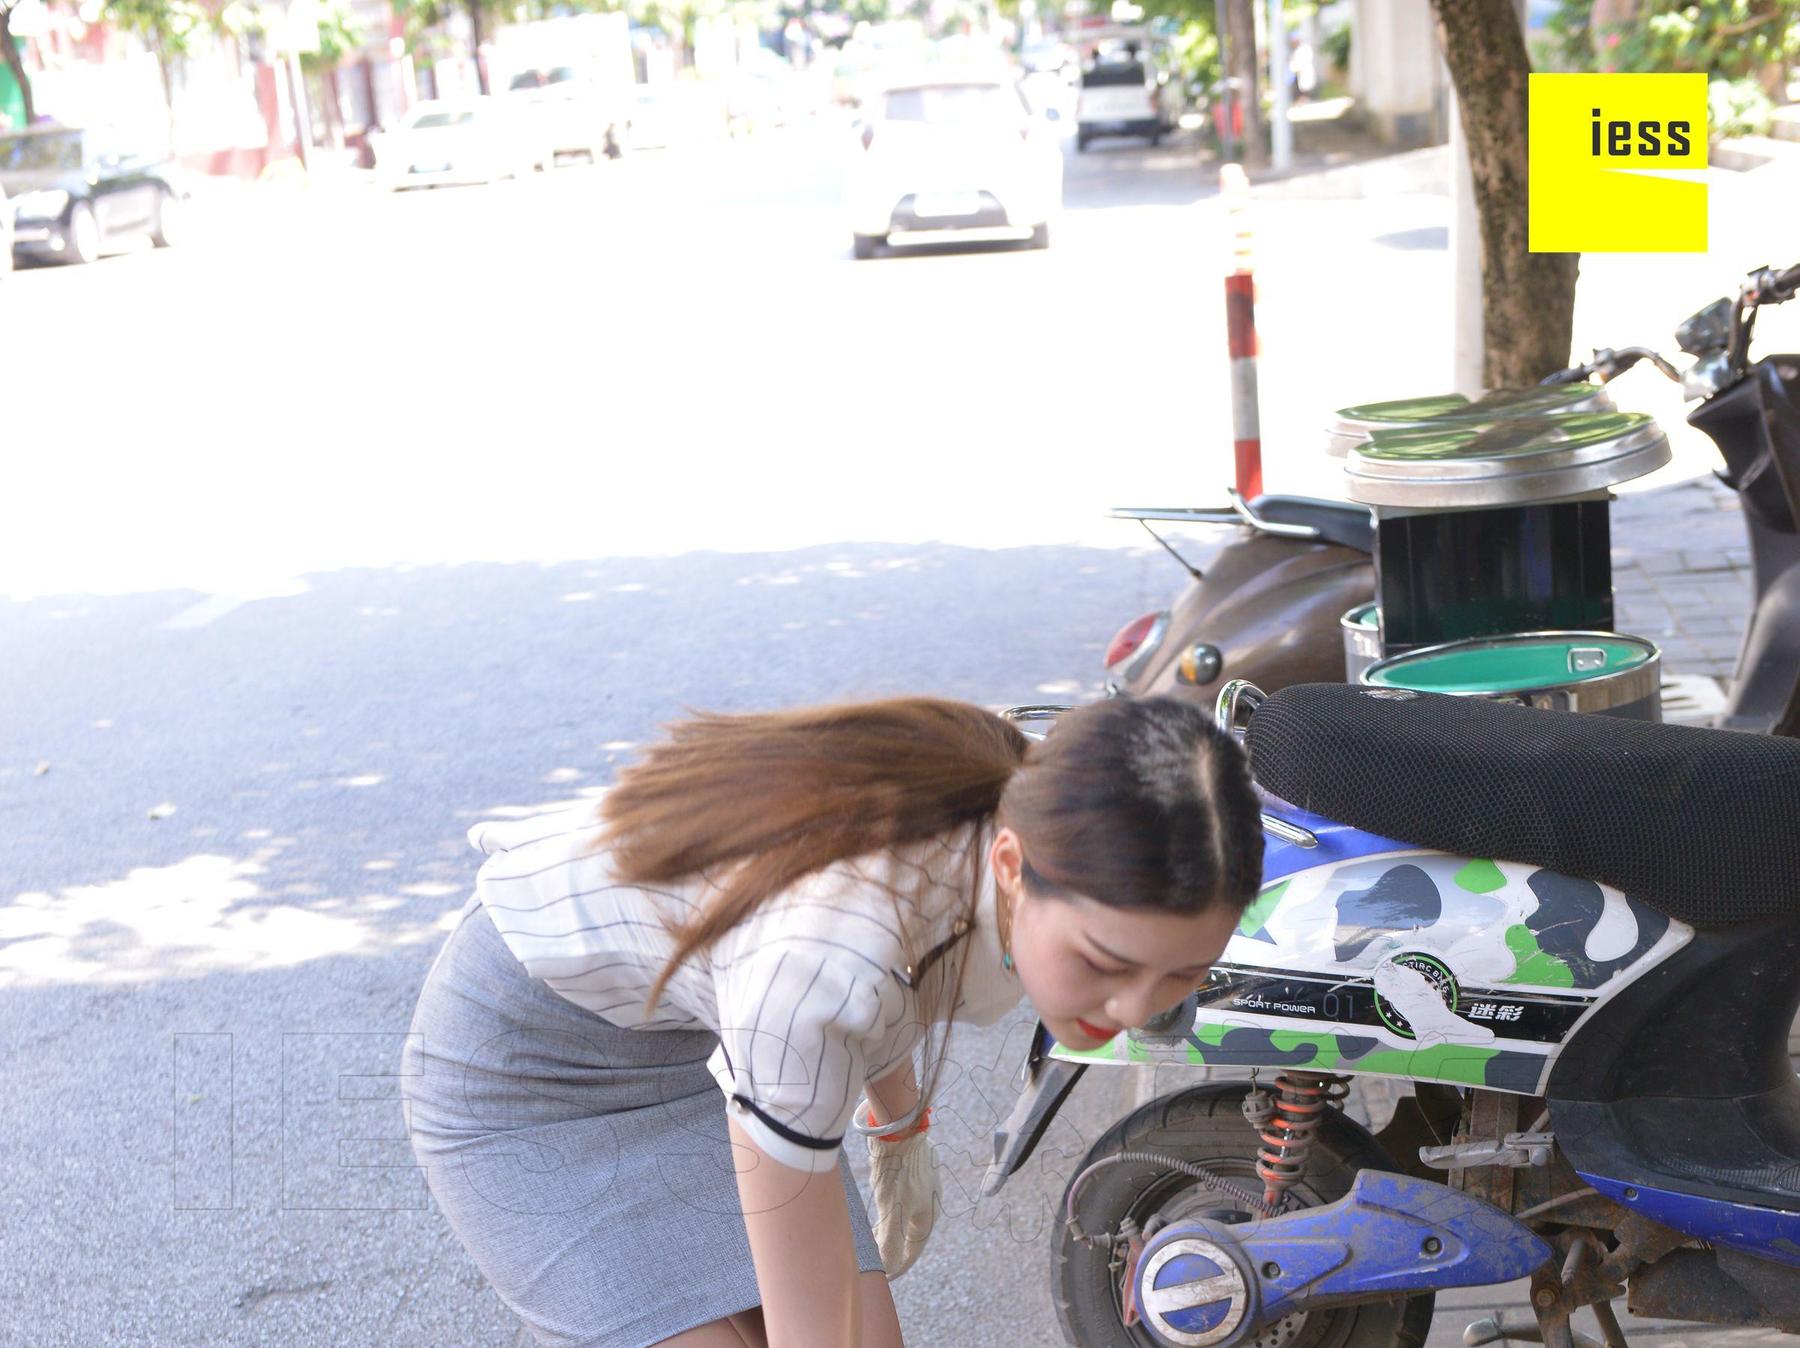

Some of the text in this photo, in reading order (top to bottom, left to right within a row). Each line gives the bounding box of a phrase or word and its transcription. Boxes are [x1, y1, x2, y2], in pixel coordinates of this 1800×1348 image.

[1233, 998, 1271, 1010] SPORT
[1273, 1003, 1316, 1014] POWER
[1468, 1003, 1524, 1021] 迷彩
